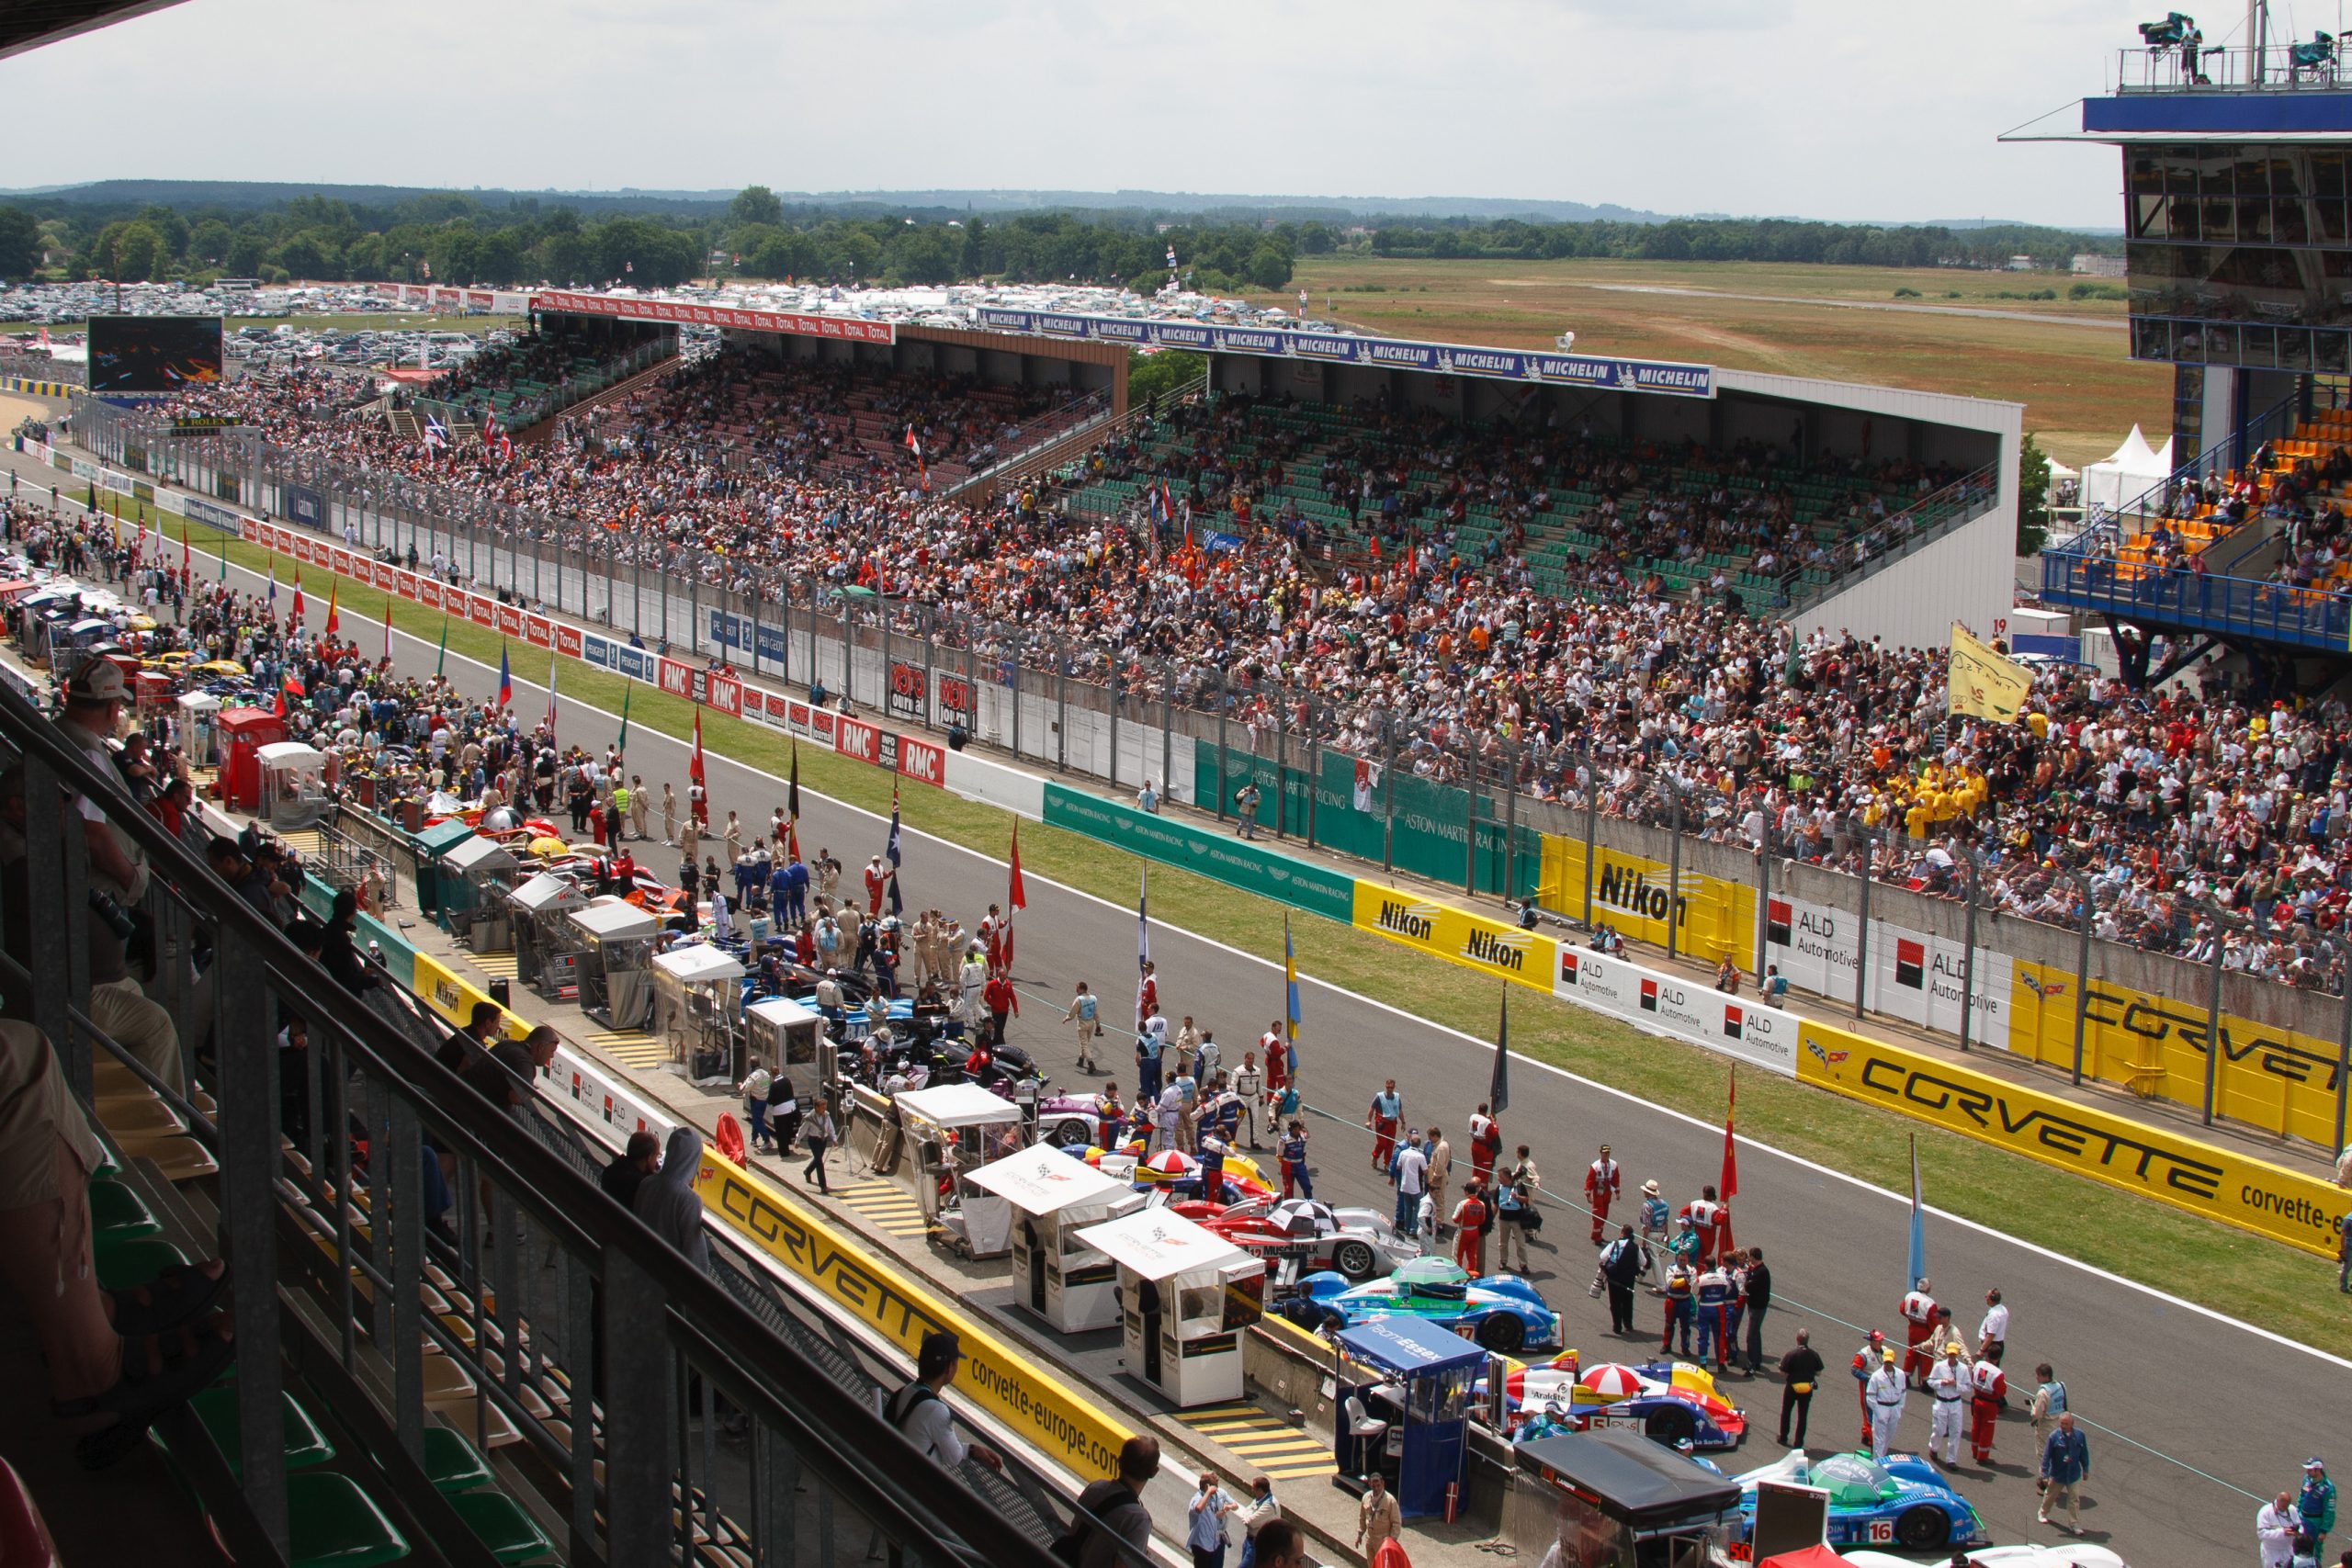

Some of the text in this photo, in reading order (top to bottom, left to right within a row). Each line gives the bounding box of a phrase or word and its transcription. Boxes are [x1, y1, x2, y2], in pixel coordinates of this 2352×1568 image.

[604, 300, 618, 312] TOTAL
[621, 302, 636, 313] TOTAL
[639, 303, 653, 315] TOTAL
[656, 305, 673, 317] TOTAL
[674, 307, 691, 319] TOTAL
[694, 309, 710, 321] TOTAL
[713, 310, 730, 323] TOTAL
[733, 312, 752, 325] TOTAL
[754, 314, 773, 327] TOTAL
[989, 313, 1026, 326] MICHELIN
[775, 317, 795, 330] TOTAL
[797, 319, 818, 333] TOTAL
[820, 321, 841, 334] TOTAL
[843, 323, 864, 337] TOTAL
[1044, 318, 1082, 332] MICHELIN
[1101, 322, 1142, 337] MICHELIN
[867, 325, 888, 340] TOTAL
[1161, 329, 1206, 343] MICHELIN
[1227, 333, 1275, 348] MICHELIN
[1298, 338, 1349, 355] MICHELIN
[1374, 346, 1429, 362] MICHELIN
[1455, 353, 1514, 370] MICHELIN
[1544, 360, 1608, 378] MICHELIN
[1638, 369, 1708, 387] MICHELIN
[192, 418, 228, 426] ROLEX
[315, 547, 328, 561] TOTAL
[335, 555, 348, 569] TOTAL
[356, 561, 369, 576] TOTAL
[378, 569, 391, 584] TOTAL
[400, 577, 414, 592] TOTAL
[423, 585, 438, 601] TOTAL
[447, 593, 463, 610] TOTAL
[473, 603, 491, 619] TOTAL
[501, 612, 518, 629] TOTAL
[1994, 619, 2007, 633] 19
[528, 621, 548, 639] TOTAL
[560, 632, 579, 651] TOTAL
[587, 643, 606, 660] PEUGEOT
[621, 656, 641, 671] PEUGEOT
[664, 663, 685, 694] RMC
[695, 672, 705, 682] INFO
[694, 682, 706, 691] TALK
[692, 691, 707, 701] SPORT
[713, 680, 735, 711] RMC
[744, 691, 762, 706] MOTO
[744, 704, 762, 720] journal
[767, 697, 785, 715] MOTO
[767, 713, 785, 728] journal
[790, 705, 808, 724] MOTO
[813, 713, 832, 732] MOTO
[790, 720, 808, 735] journal
[813, 728, 832, 744] journal
[842, 721, 871, 757] RMC
[881, 734, 896, 747] INFO
[881, 744, 896, 758] TALK
[878, 753, 897, 768] SPORT
[906, 746, 936, 781] RMC
[1066, 803, 1111, 823] ASTON MARTIN RACING
[1405, 814, 1435, 834] ASTON
[1136, 825, 1183, 847] ASTON MARTIN RACING
[1210, 850, 1262, 873] ASTON MARTIN RACING
[1292, 875, 1349, 901] ASTON MARTIN RACING
[1599, 863, 1687, 928] Nikon
[1381, 900, 1430, 941] Nikon
[1799, 911, 1834, 939] ALD
[1468, 928, 1522, 971] Nikon
[1797, 936, 1859, 970] Automotive
[1580, 961, 1602, 979] ALD
[435, 978, 459, 1013] Nikon
[1580, 977, 1618, 999] Automotive
[1661, 987, 1685, 1006] ALD
[1660, 1005, 1701, 1027] Automotive
[1747, 1014, 1771, 1034] ALD
[1746, 1032, 1789, 1056] Automotive
[551, 1060, 562, 1076] ALD
[582, 1080, 593, 1096] ALD
[614, 1103, 625, 1120] ALD
[1861, 1057, 2223, 1200] CORVETTE
[1295, 1244, 1318, 1254] MILK
[722, 1178, 959, 1338] CORVETT
[1455, 1327, 1474, 1340] 17
[1533, 1392, 1566, 1402] Araldite
[1593, 1418, 1604, 1429] 5
[1870, 1523, 1891, 1540] 16
[1729, 1543, 1751, 1562] 50
